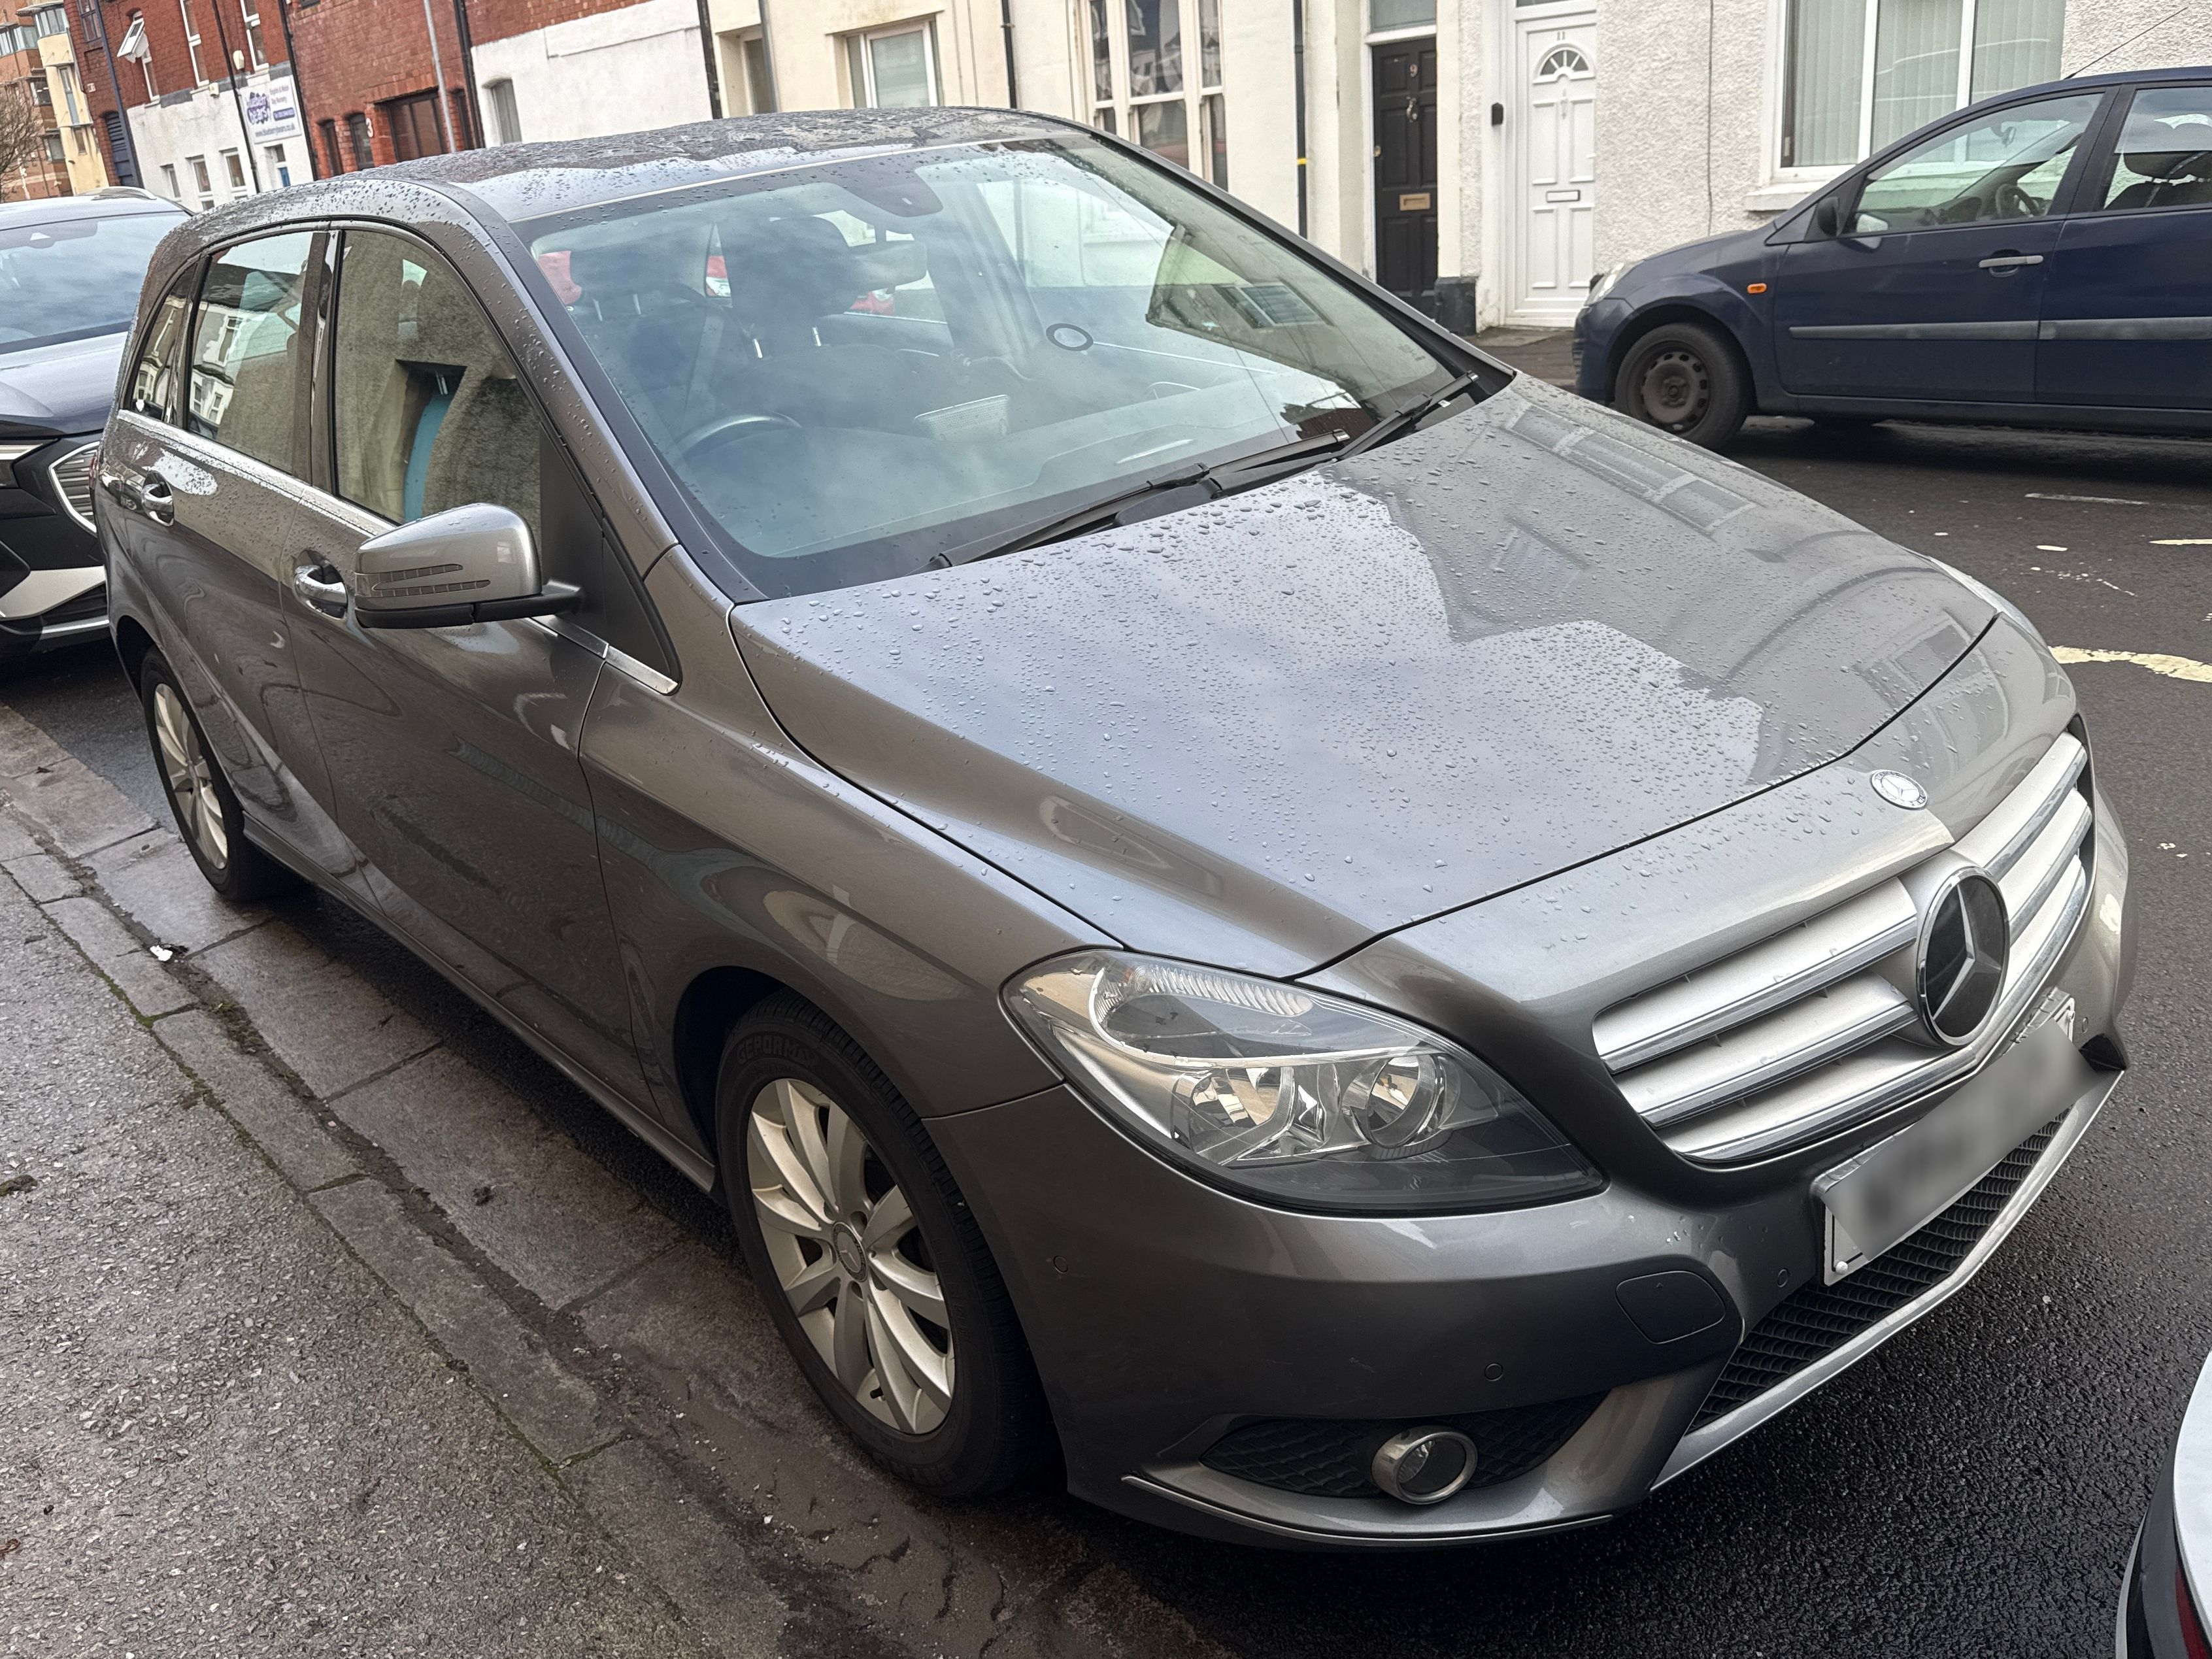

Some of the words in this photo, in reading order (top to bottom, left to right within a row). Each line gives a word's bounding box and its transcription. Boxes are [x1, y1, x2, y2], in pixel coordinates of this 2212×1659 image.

[1557, 31, 1566, 41] 11
[1410, 64, 1418, 77] 9
[365, 117, 373, 137] 3
